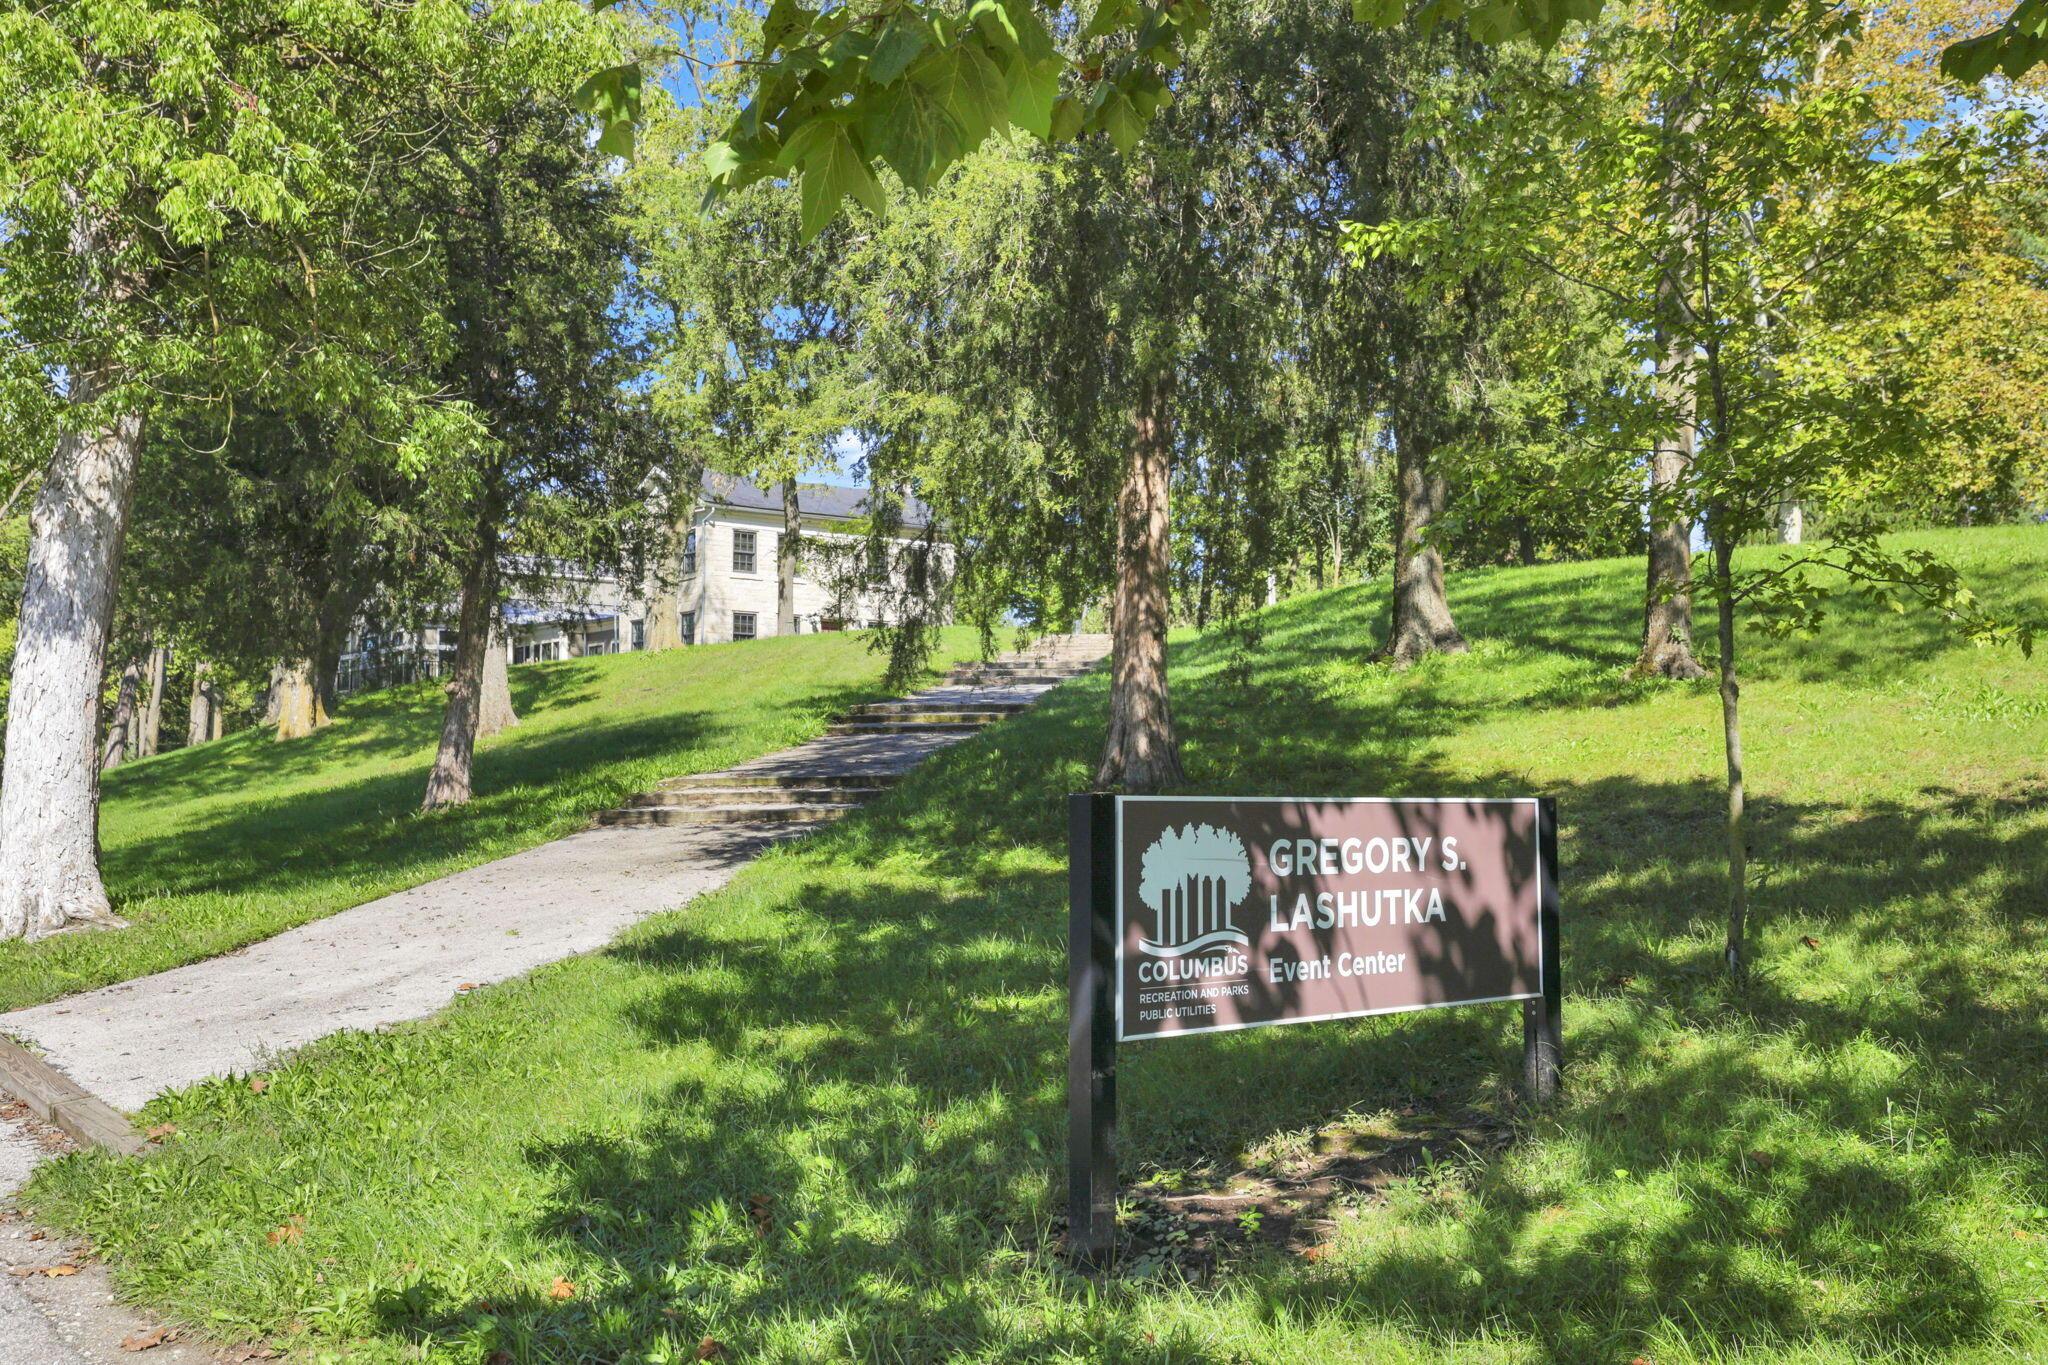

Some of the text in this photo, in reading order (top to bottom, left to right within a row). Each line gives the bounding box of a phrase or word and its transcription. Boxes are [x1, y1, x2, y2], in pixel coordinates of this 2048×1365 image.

[1269, 836, 1466, 877] GREGORY S.
[1270, 887, 1447, 932] LASHUTKA
[1138, 954, 1249, 983] COLUMBUS
[1269, 951, 1406, 983] Event Center
[1139, 985, 1249, 1004] RECREATION AND PARKS
[1139, 1004, 1217, 1021] PUBLIC UTILITIES
